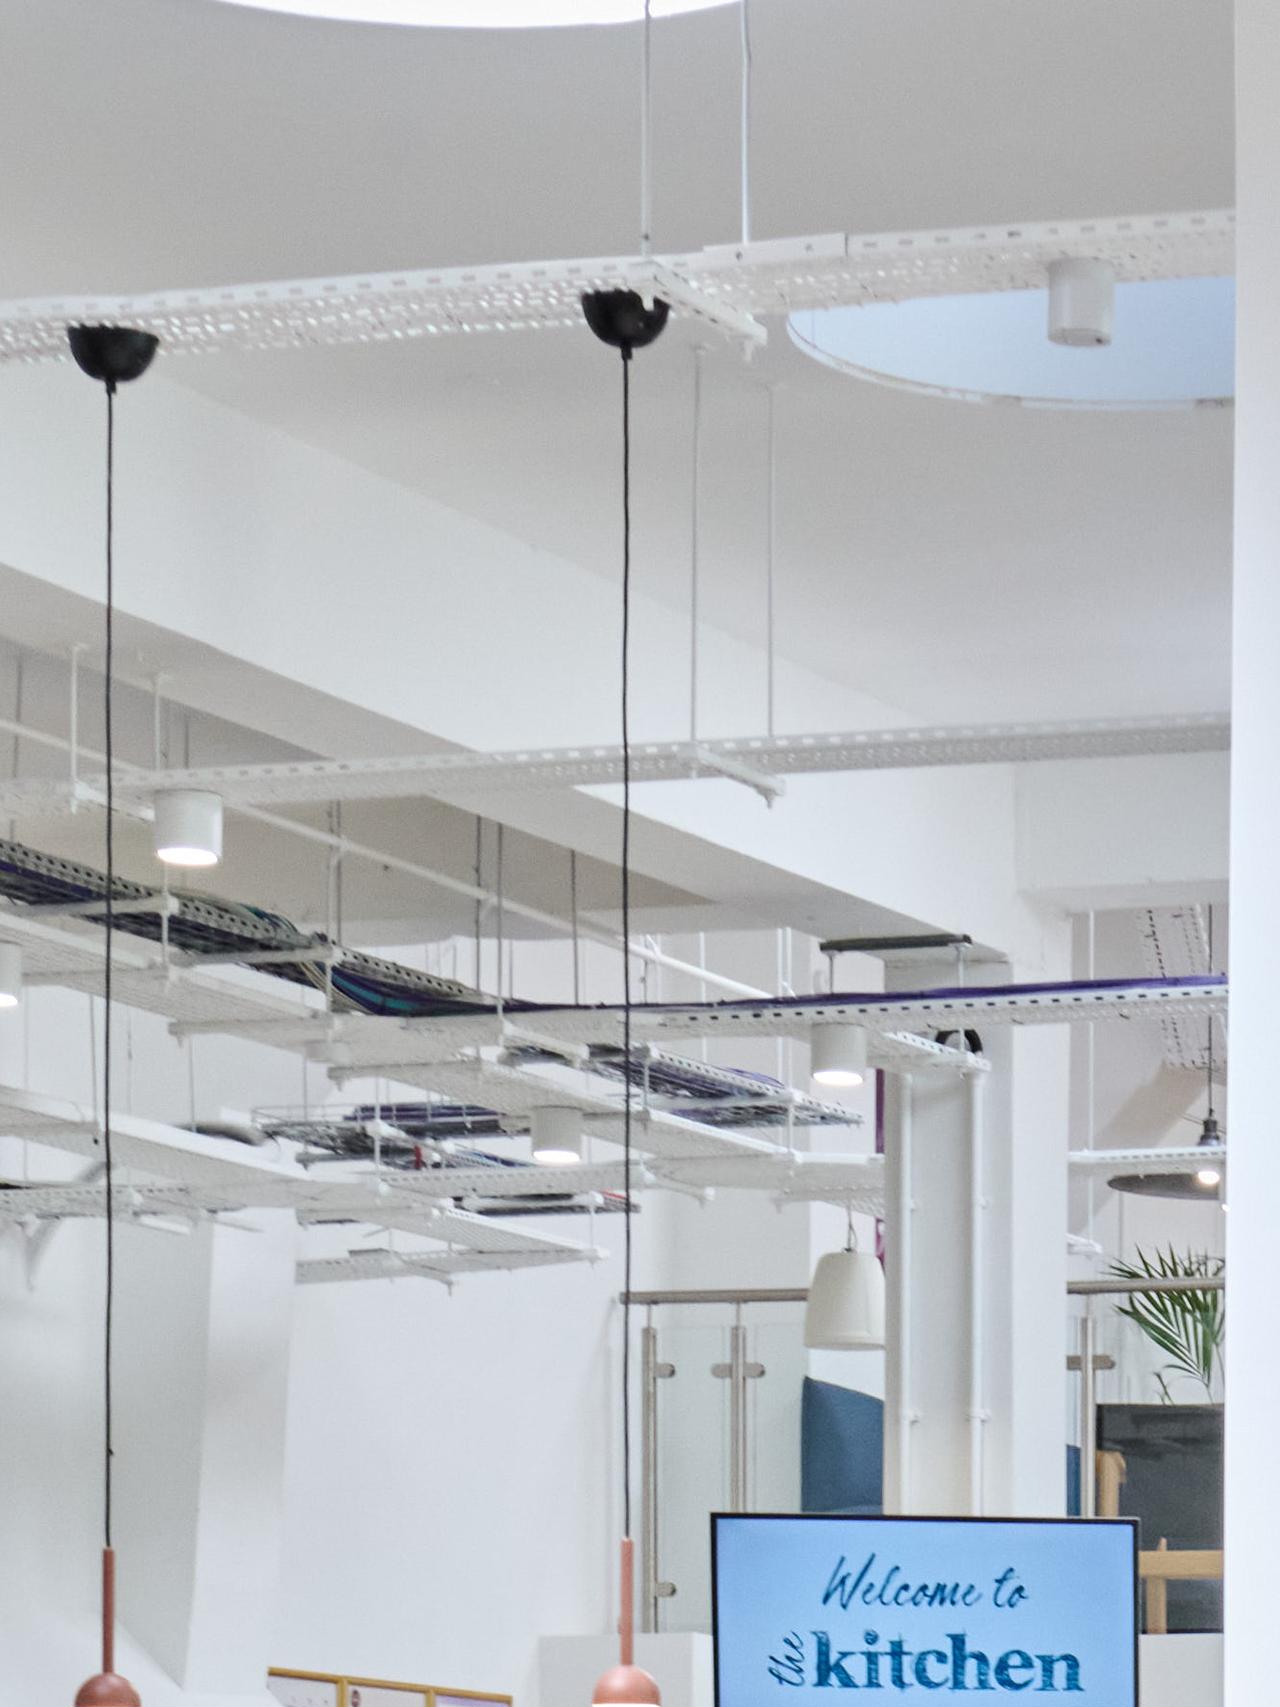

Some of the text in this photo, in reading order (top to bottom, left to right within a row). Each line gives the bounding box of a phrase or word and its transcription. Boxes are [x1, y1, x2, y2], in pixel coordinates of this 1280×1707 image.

[821, 1552, 1029, 1611] Welcome to
[767, 1628, 1085, 1692] the kitchen
